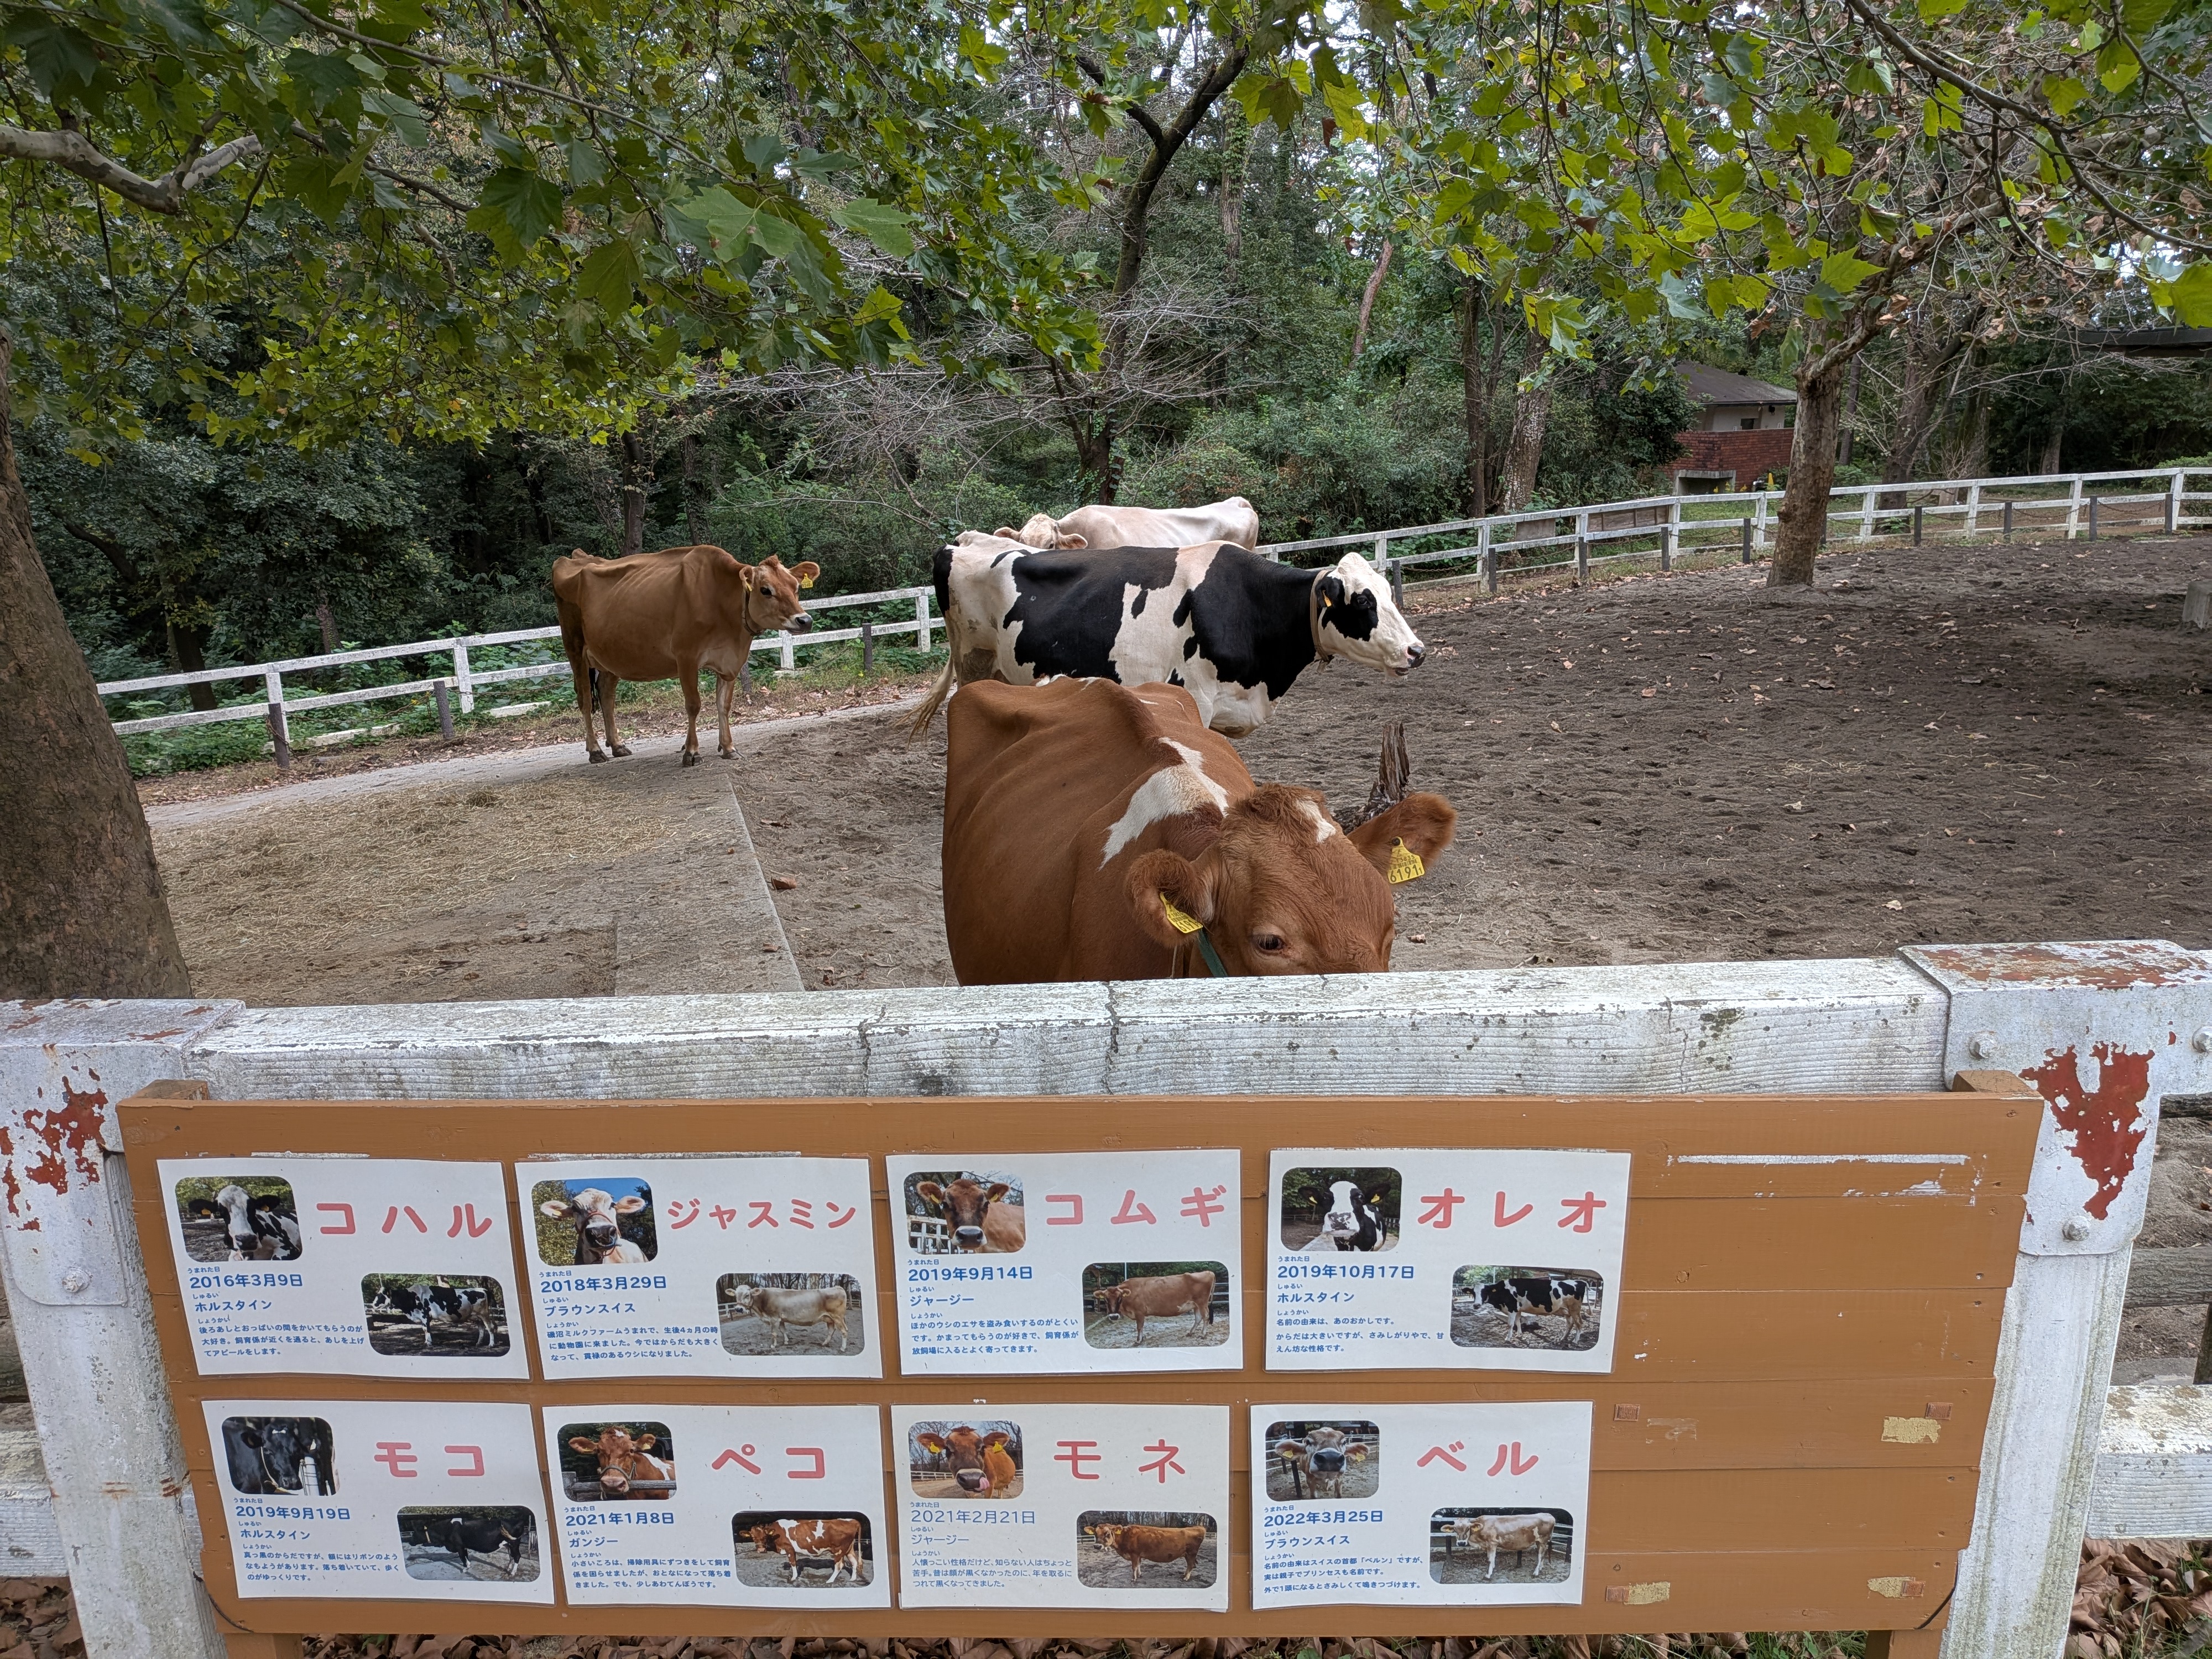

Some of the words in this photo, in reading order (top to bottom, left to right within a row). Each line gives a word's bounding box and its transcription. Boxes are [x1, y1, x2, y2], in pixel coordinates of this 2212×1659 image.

[667, 1198, 856, 1229] ジャスミン
[1045, 1185, 1227, 1228] コムギ
[1417, 1187, 1607, 1234] オレオ
[316, 1203, 493, 1238] コハル
[908, 1266, 1032, 1281] 2019年9月14日
[1277, 1264, 1414, 1279] 2019年10月17日
[189, 1273, 303, 1289] 2016年3月9日
[541, 1276, 666, 1293] 2018年3月29日
[910, 1294, 974, 1306] ジャージー
[1277, 1292, 1354, 1303] ホルスタイン
[195, 1300, 272, 1313] ホルスタイン
[545, 1302, 635, 1317] ブラウンスイス
[911, 1318, 1078, 1329] ほかのウシのエサを盗み食いするのがとくい
[1276, 1317, 1395, 1326] 名前の由来は、あのおかしです。
[199, 1324, 362, 1334] 後ろあしとおっぱいの間をかいてもらうのが
[1276, 1332, 1444, 1340] からだは大きいですが、さみしがりやで、甘
[201, 1337, 364, 1345] 大好き。飼育係が近くを通ると、あしを上げ
[912, 1331, 1079, 1342] です。かまってもらうのが好きで、飼育係が
[549, 1339, 718, 1350] に動物園に来ました。今ではからだも大きく
[912, 1345, 1037, 1355] 放飼場に入るとよく寄ってきます。
[1276, 1344, 1344, 1353] えん坊な性格です。
[204, 1348, 281, 1357] てアピールをします。
[374, 1442, 485, 1478] モコ
[711, 1443, 825, 1479] ペコ
[1053, 1438, 1186, 1484] モネ
[1416, 1441, 1539, 1477] ベル
[236, 1506, 350, 1520] 2019年9月19日
[1264, 1505, 1294, 1513] うまれた日
[566, 1512, 674, 1526] 2021年1月8日
[911, 1510, 1035, 1524] 2021年2月21日
[1264, 1510, 1383, 1527] 2022年3月25日
[241, 1530, 310, 1540] ホルスタイン
[911, 1534, 969, 1545] ジャージー
[570, 1537, 618, 1548] ガンジー
[1265, 1535, 1350, 1550] ブラウンスイス
